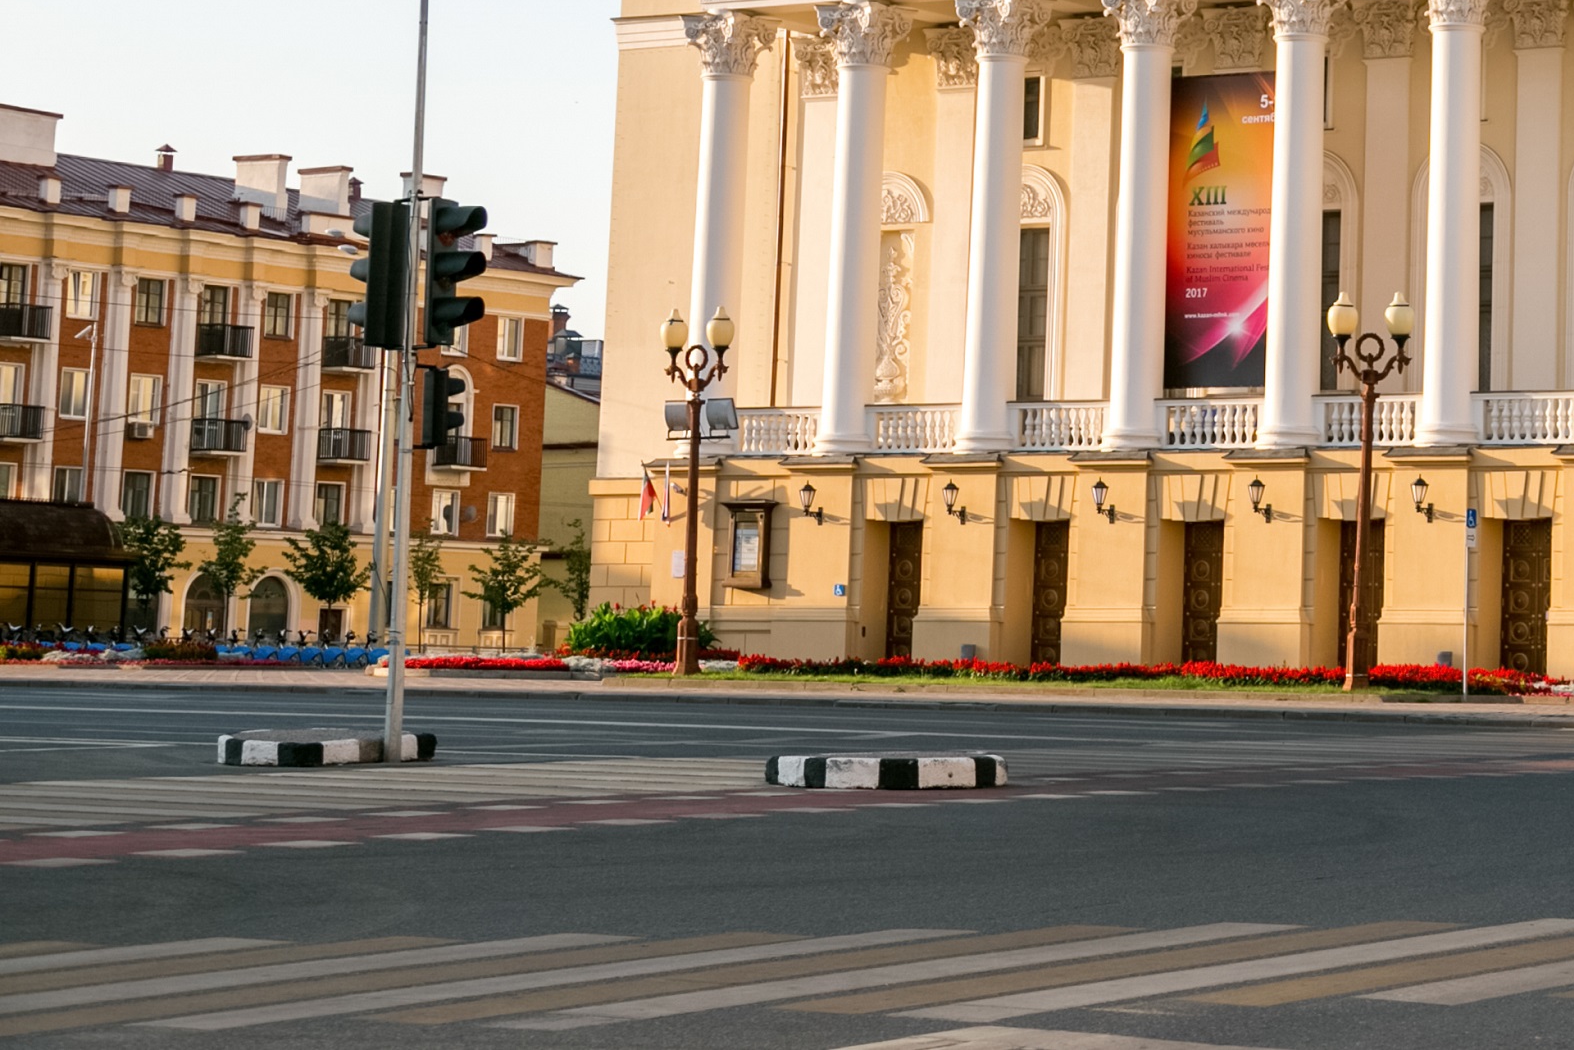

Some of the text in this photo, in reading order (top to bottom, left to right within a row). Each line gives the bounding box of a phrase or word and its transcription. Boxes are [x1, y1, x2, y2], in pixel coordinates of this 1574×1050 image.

[1260, 93, 1274, 109] 5-
[1241, 111, 1275, 124] сентяб
[1188, 185, 1227, 206] XIII
[1187, 207, 1271, 217] Казанский международ
[1187, 219, 1225, 228] фестиваль
[1187, 227, 1246, 237] мусульманского
[1186, 263, 1270, 274] Kazan International Fest
[1194, 274, 1221, 283] Muslim
[1222, 273, 1249, 282] Cinema
[1185, 287, 1208, 299] 2017
